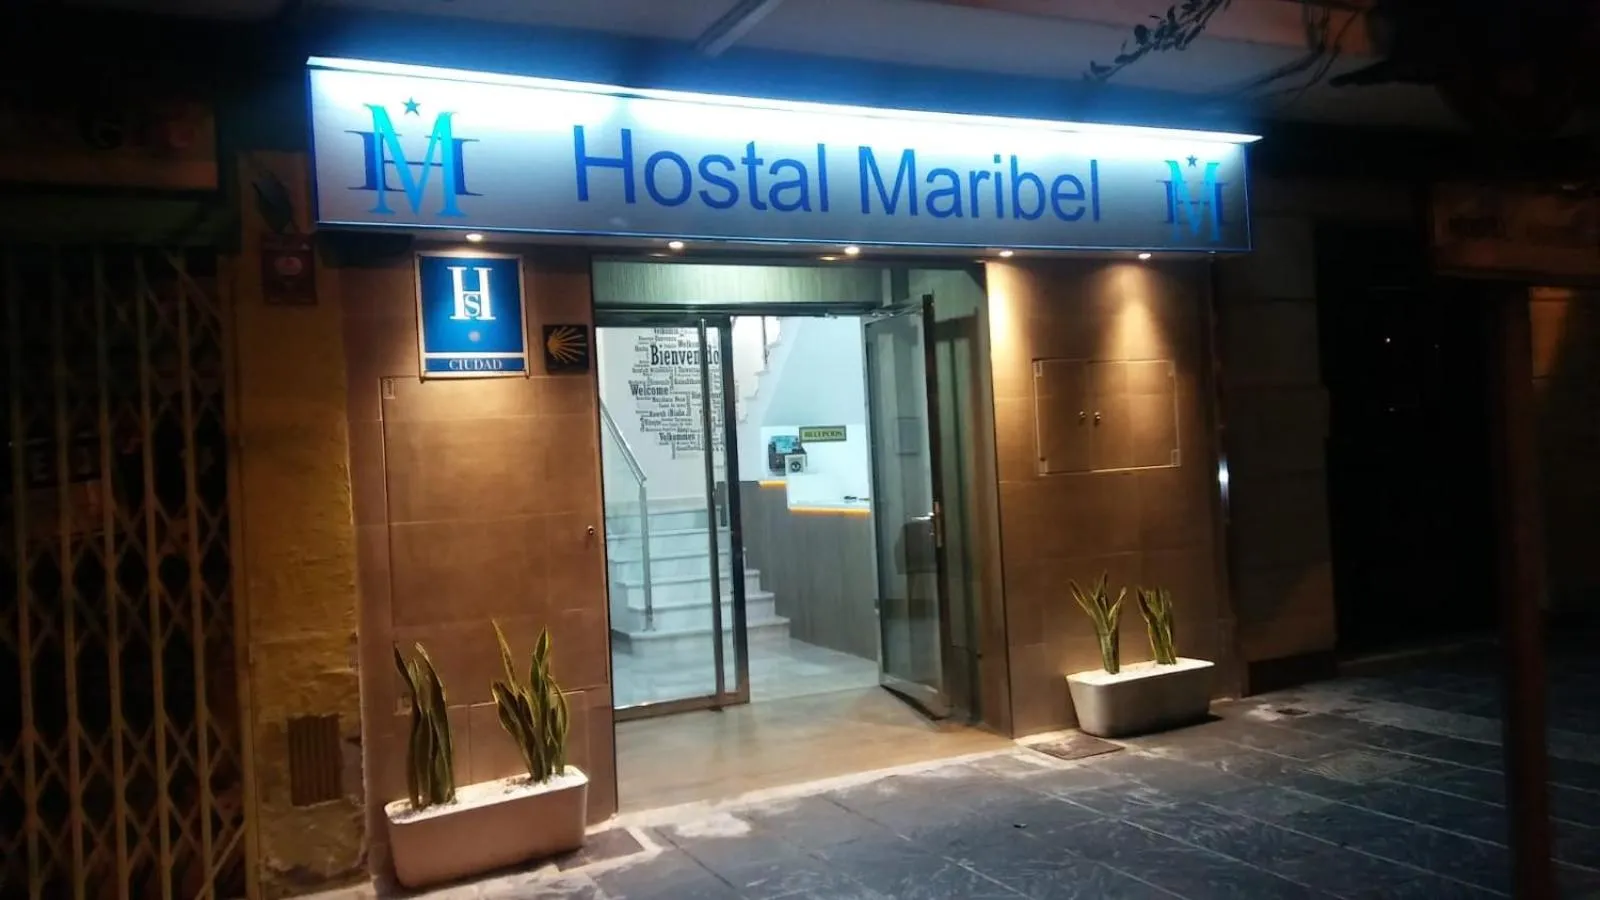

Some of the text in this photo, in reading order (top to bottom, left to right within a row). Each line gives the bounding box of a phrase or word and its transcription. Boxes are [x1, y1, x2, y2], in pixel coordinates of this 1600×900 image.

[573, 124, 1101, 223] Hostal Maribel
[449, 358, 503, 371] CIUDAD
[630, 384, 669, 397] Welcome
